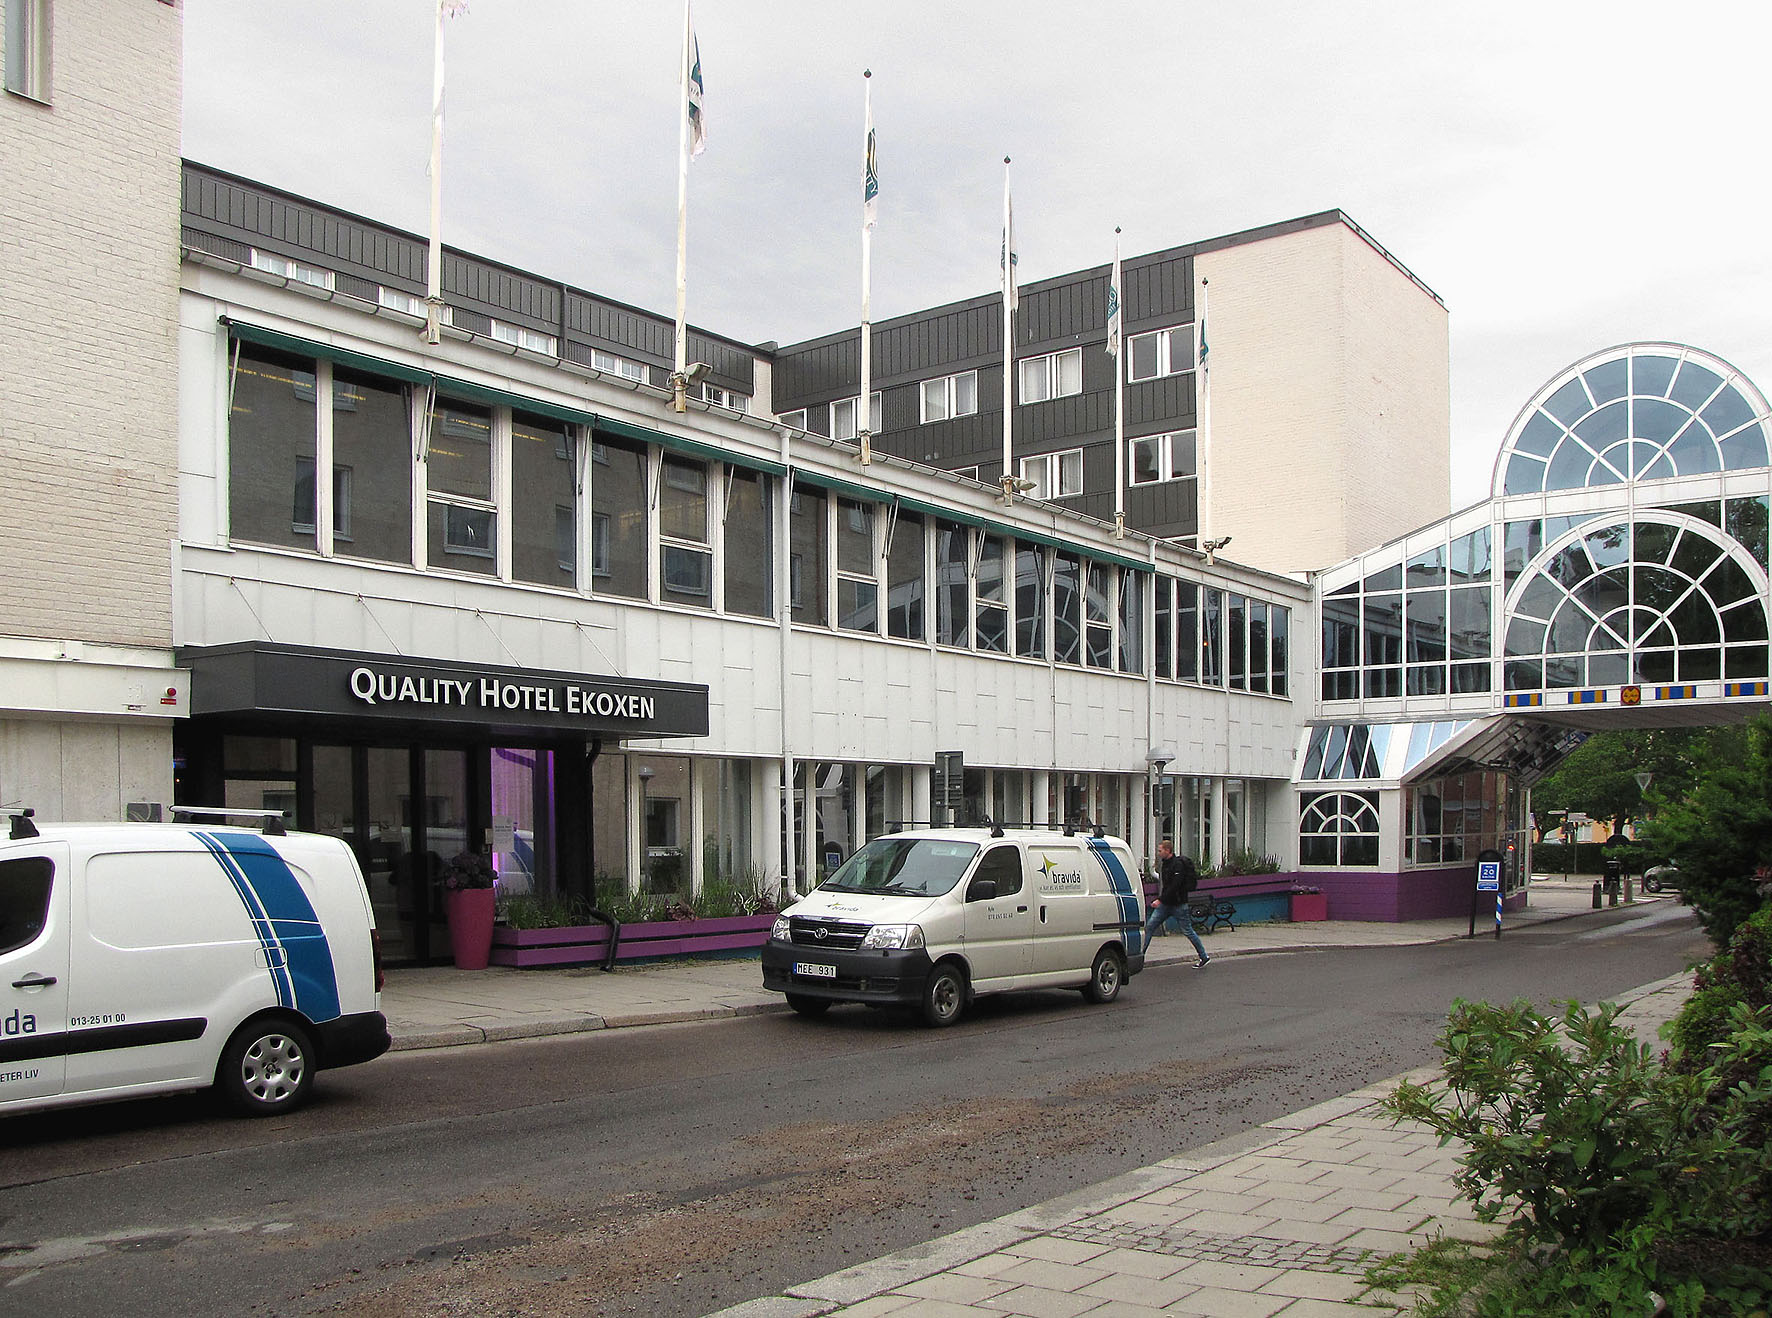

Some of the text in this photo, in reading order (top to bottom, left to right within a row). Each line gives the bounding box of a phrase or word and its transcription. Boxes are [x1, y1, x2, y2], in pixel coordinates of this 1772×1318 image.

[350, 667, 655, 719] QUALITY HOTEL EKOXEN
[1052, 870, 1081, 884] bravida
[797, 963, 834, 976] MEE 931
[0, 1008, 37, 1036] da
[71, 1013, 126, 1027] 013-25 01 00
[25, 1069, 39, 1079] LIV
